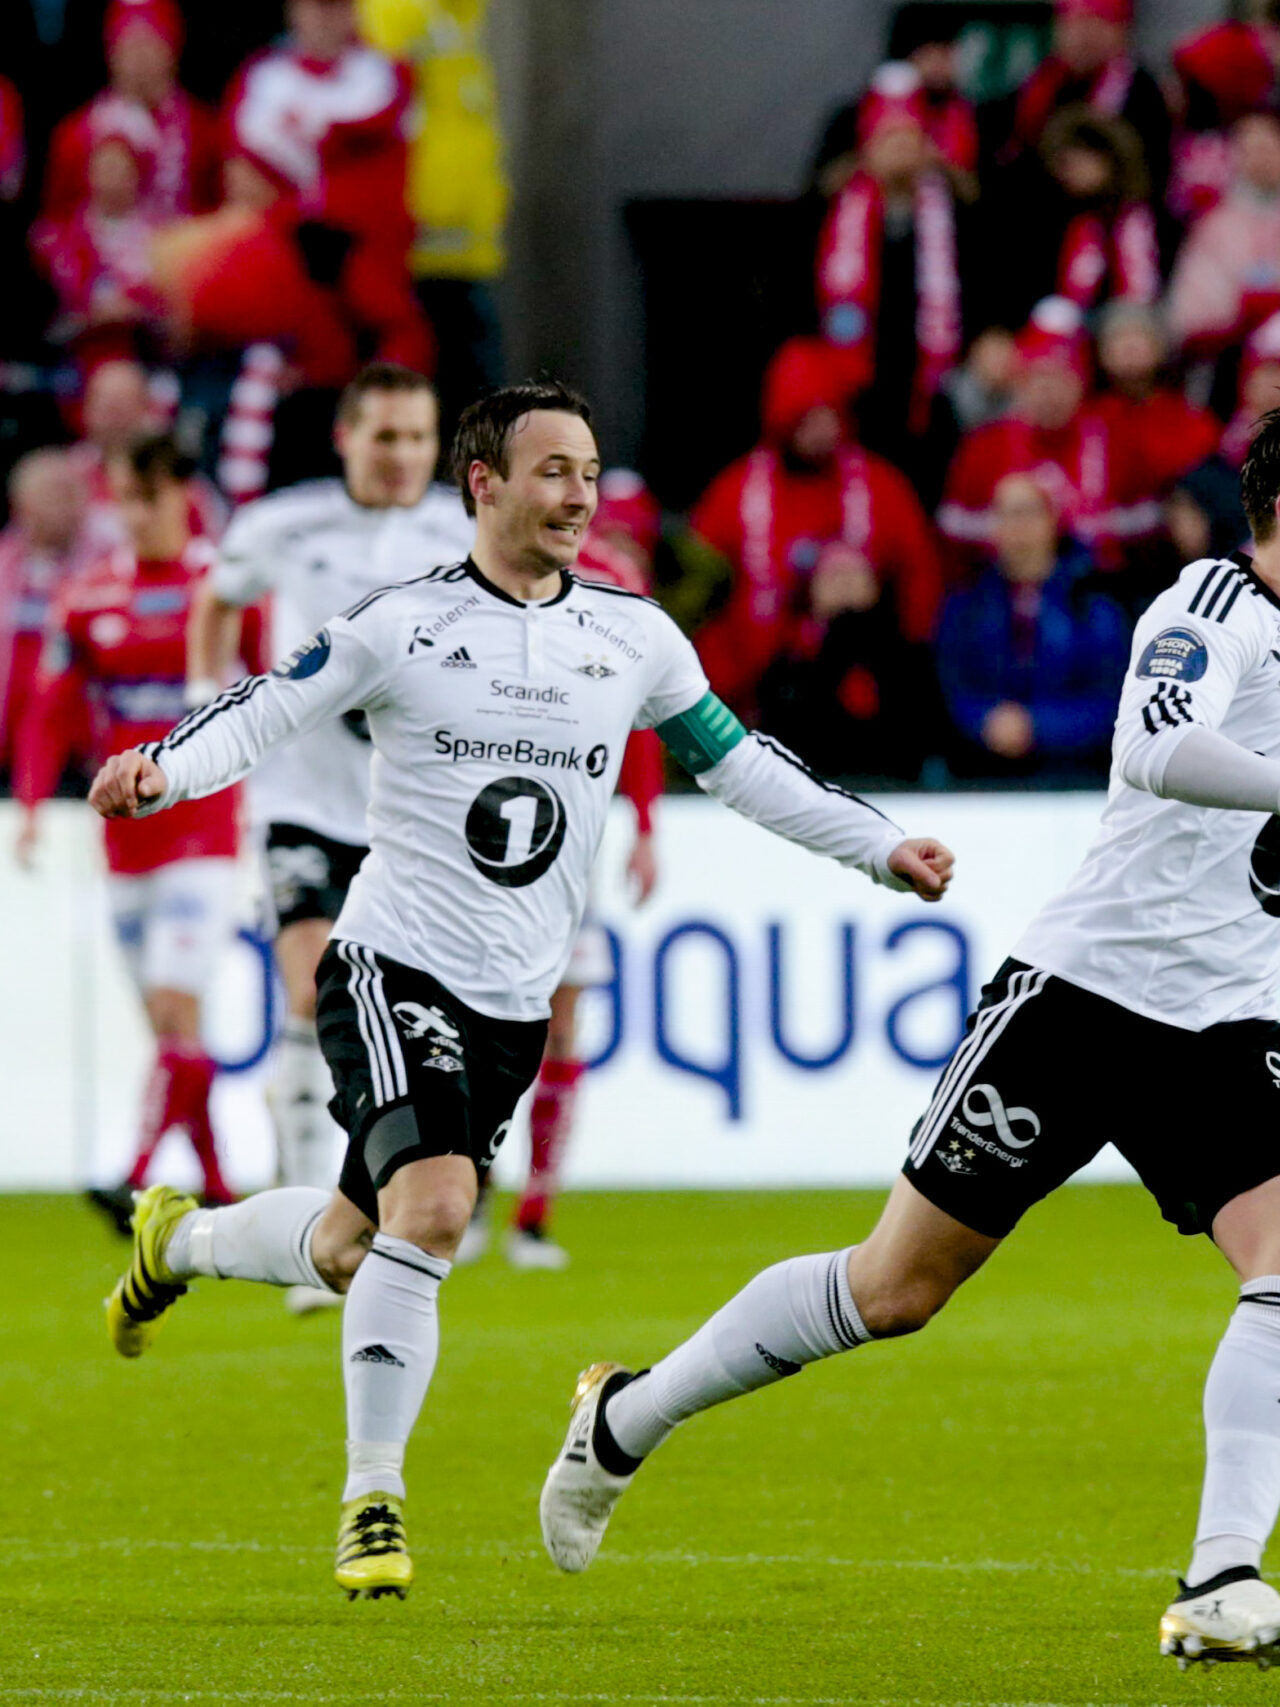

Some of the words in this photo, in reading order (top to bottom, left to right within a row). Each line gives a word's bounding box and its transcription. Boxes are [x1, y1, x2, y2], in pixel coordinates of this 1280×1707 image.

[426, 595, 481, 637] telenor
[588, 620, 644, 663] telenor
[1154, 638, 1197, 652] THON
[440, 660, 478, 670] adidas
[489, 679, 571, 705] Scandic
[434, 730, 581, 771] SpareBank
[949, 1116, 1025, 1168] TrønderEnergi
